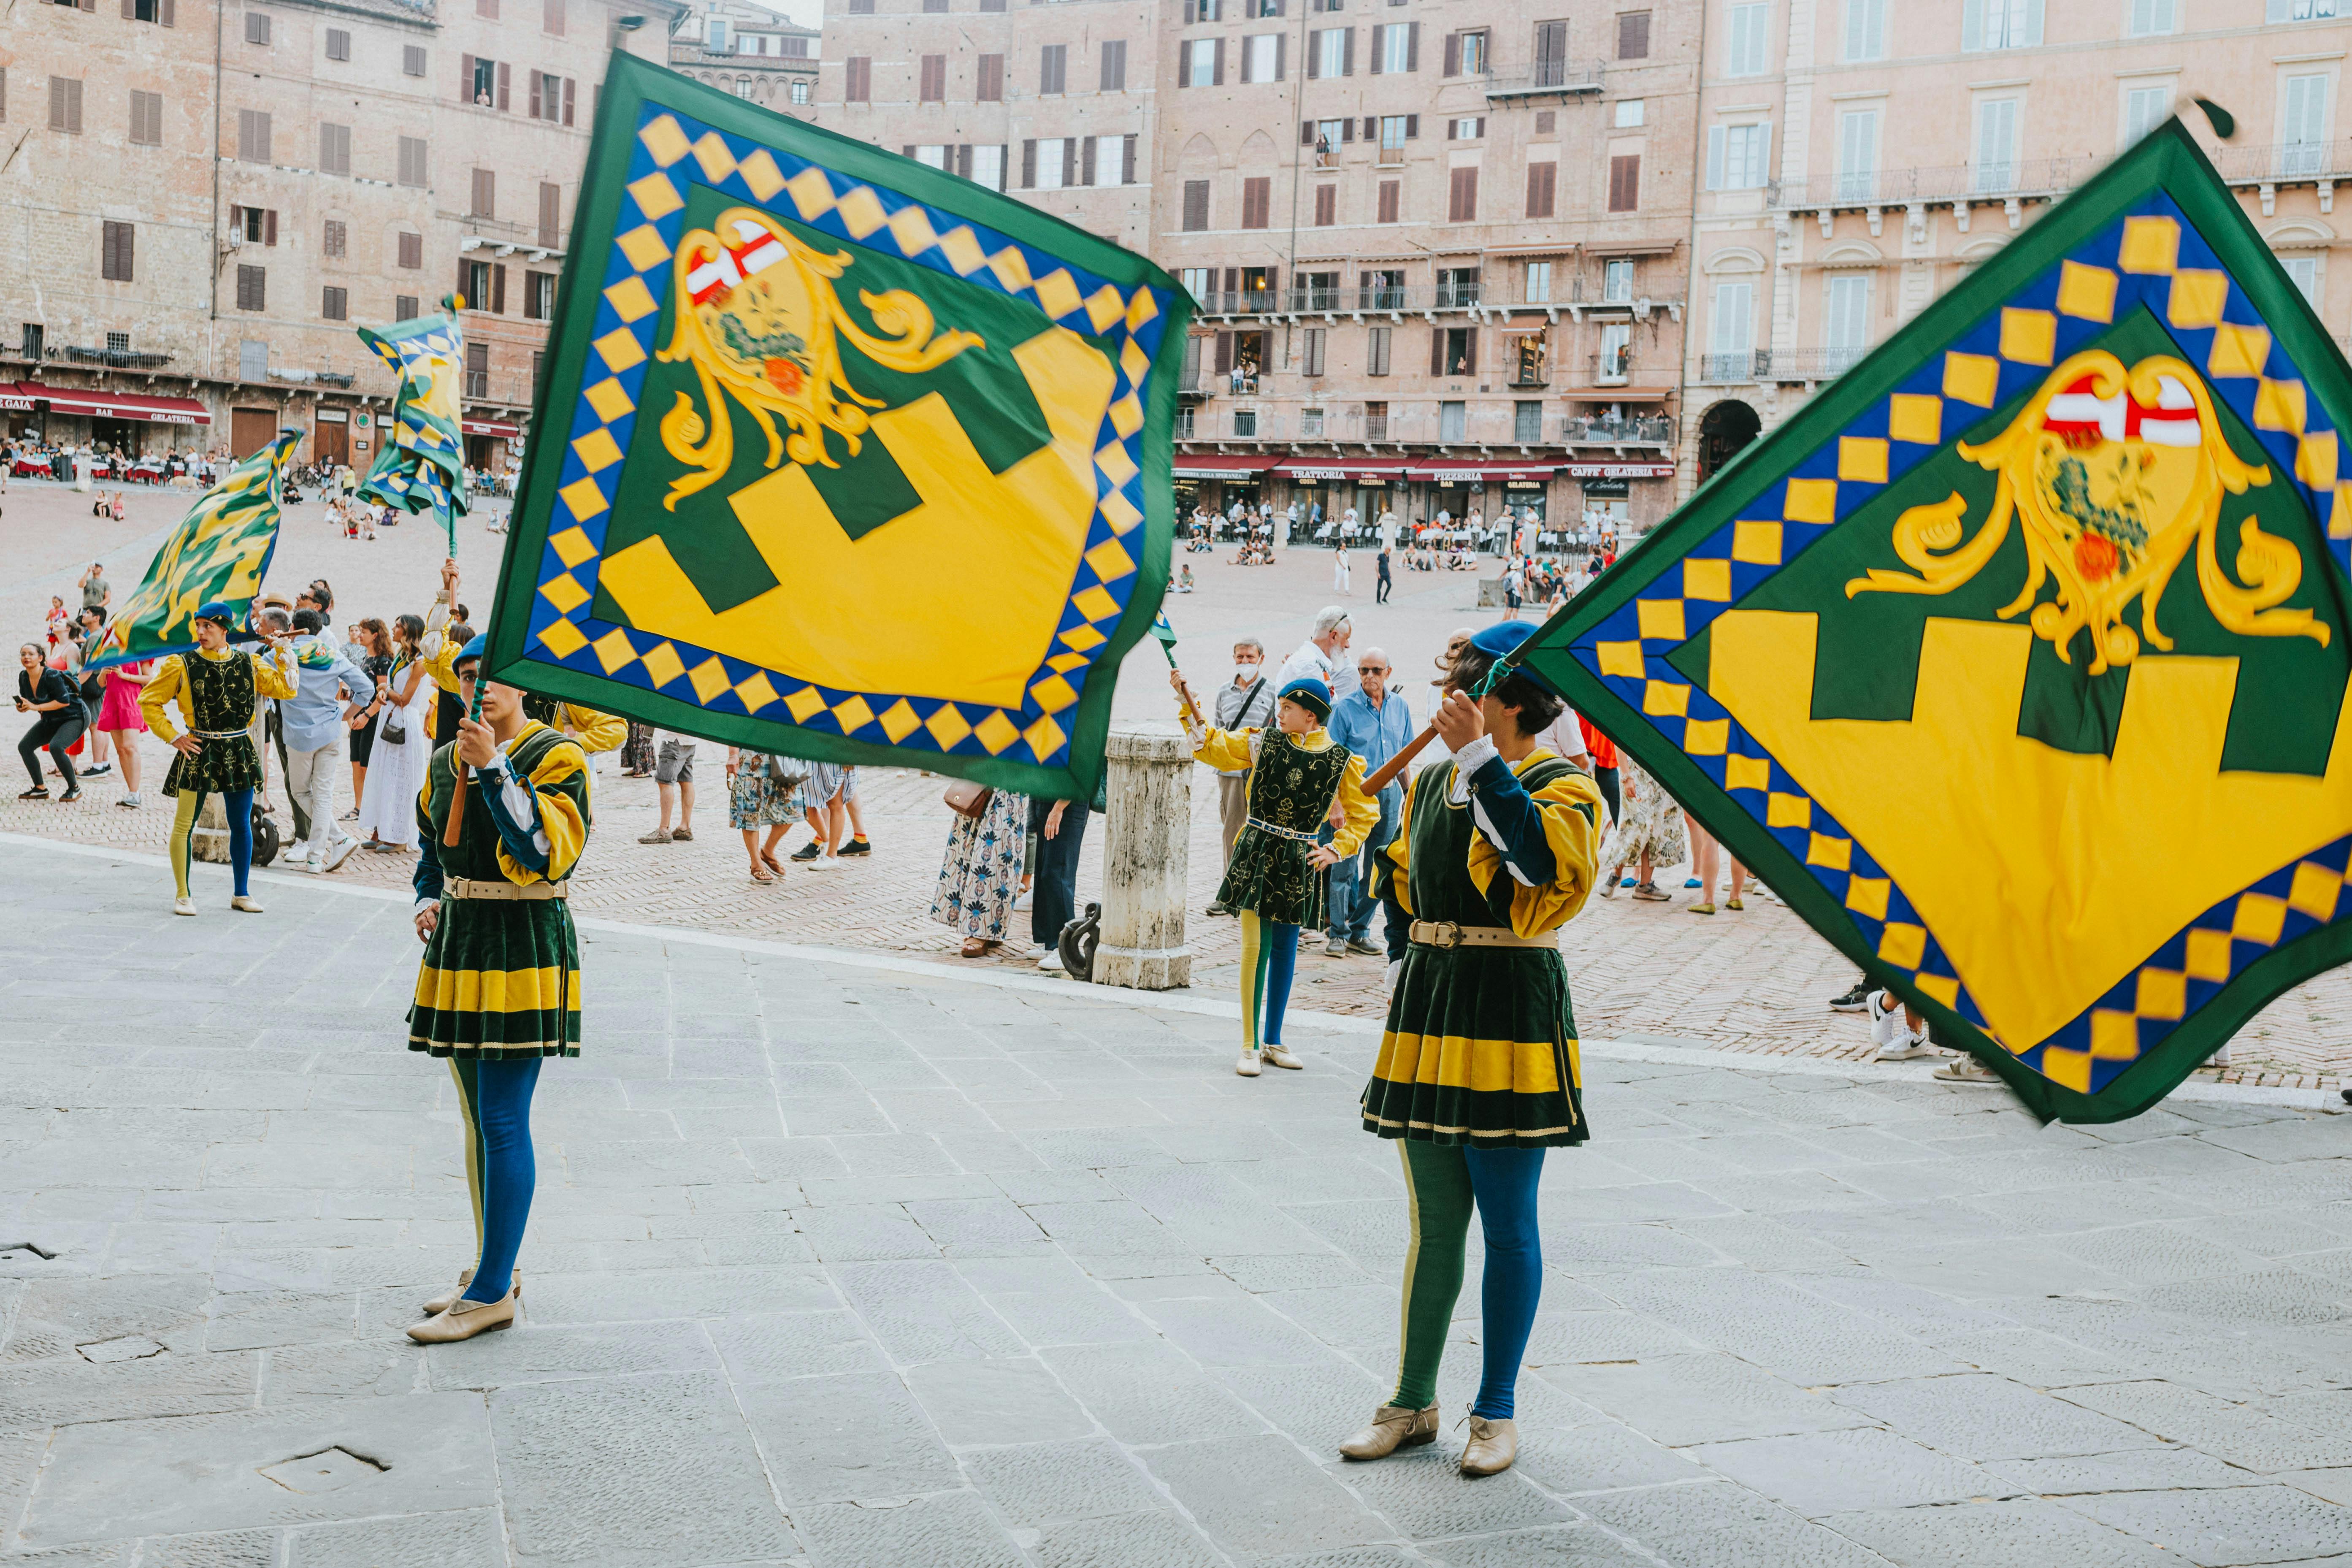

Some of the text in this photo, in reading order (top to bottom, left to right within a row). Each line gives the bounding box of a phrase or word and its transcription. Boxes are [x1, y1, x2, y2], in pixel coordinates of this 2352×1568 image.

[5, 399, 31, 409] GAIA
[96, 408, 113, 417] BAR
[151, 413, 195, 424] GELATERIA
[1291, 470, 1346, 479] TRATTORIA
[1433, 472, 1483, 481] PIZZERIA
[1604, 468, 1653, 477] GELATERIA
